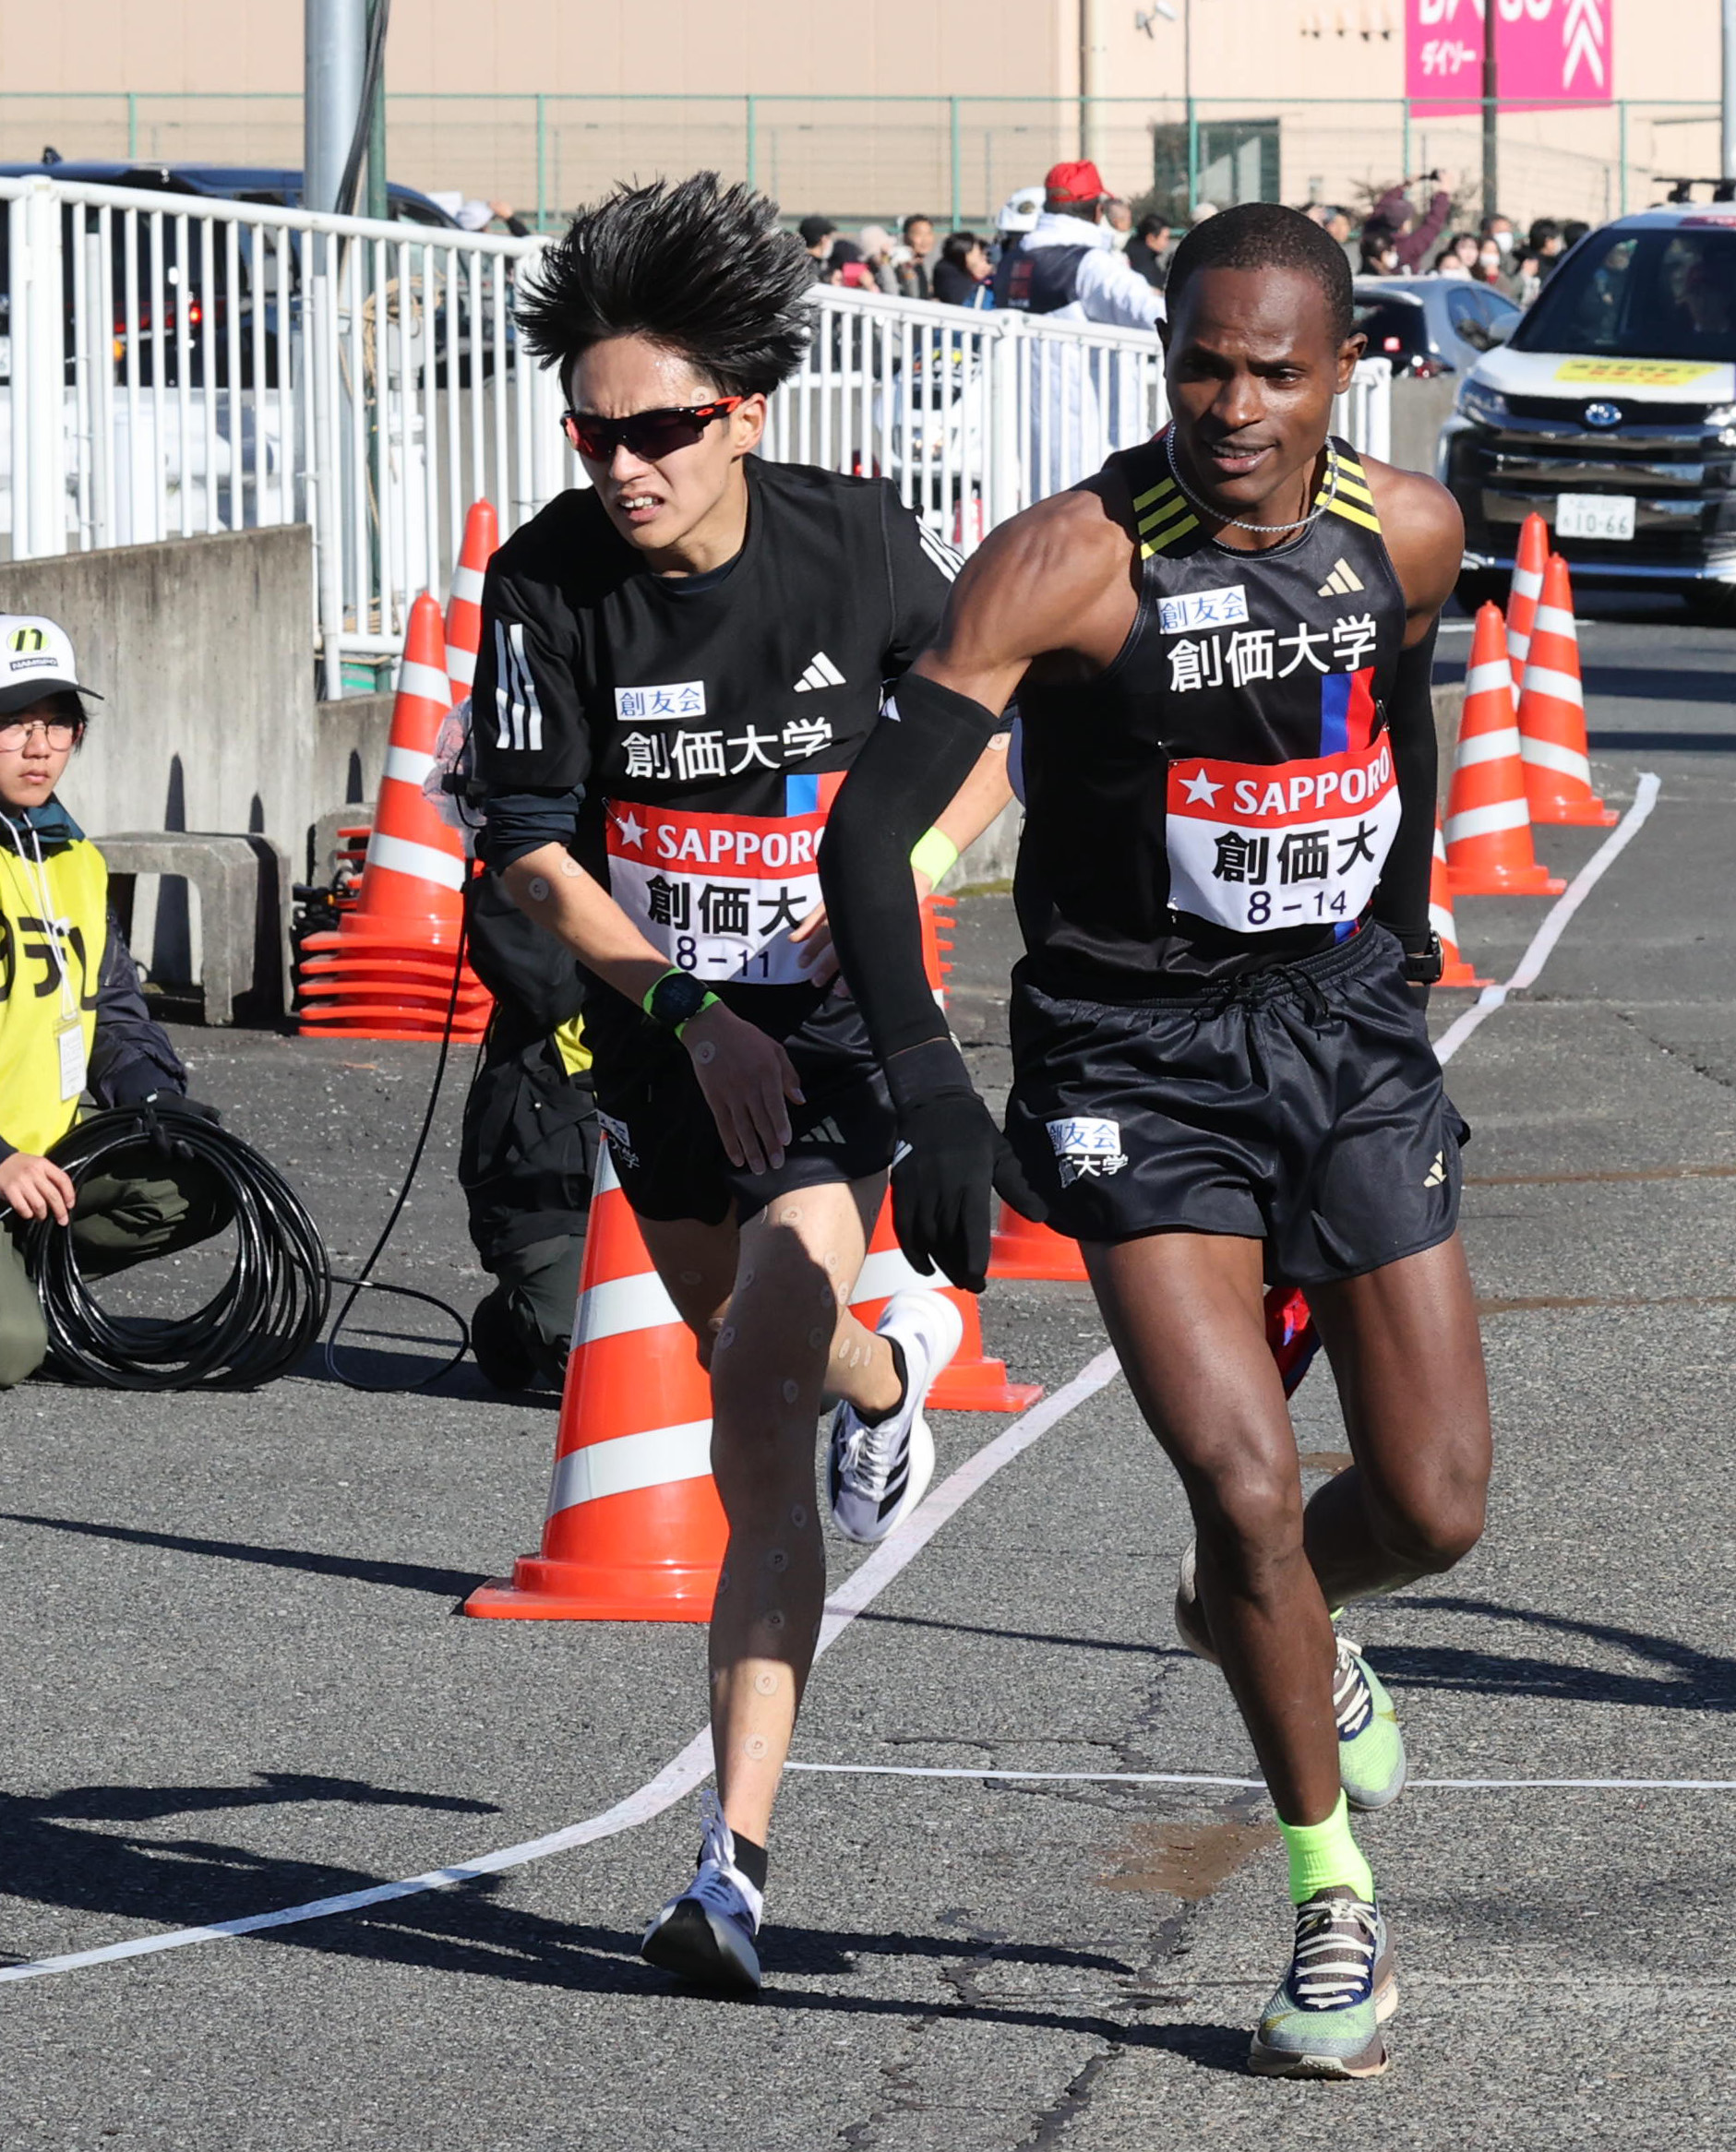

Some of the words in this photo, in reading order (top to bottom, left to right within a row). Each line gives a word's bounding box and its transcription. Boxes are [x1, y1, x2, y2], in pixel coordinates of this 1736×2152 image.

[1420, 40, 1476, 75] ダイソー
[1161, 592, 1245, 629] 創友会
[1167, 613, 1376, 692] 創価大学
[619, 687, 701, 717] 創友会
[621, 716, 833, 781] 創価大学
[1232, 746, 1390, 816] SAPPORO
[656, 824, 825, 868] SAPPOR
[1212, 820, 1379, 886] 創価大
[646, 873, 808, 937] 創価大
[1247, 890, 1347, 925] 8-14
[676, 935, 770, 978] 8-11
